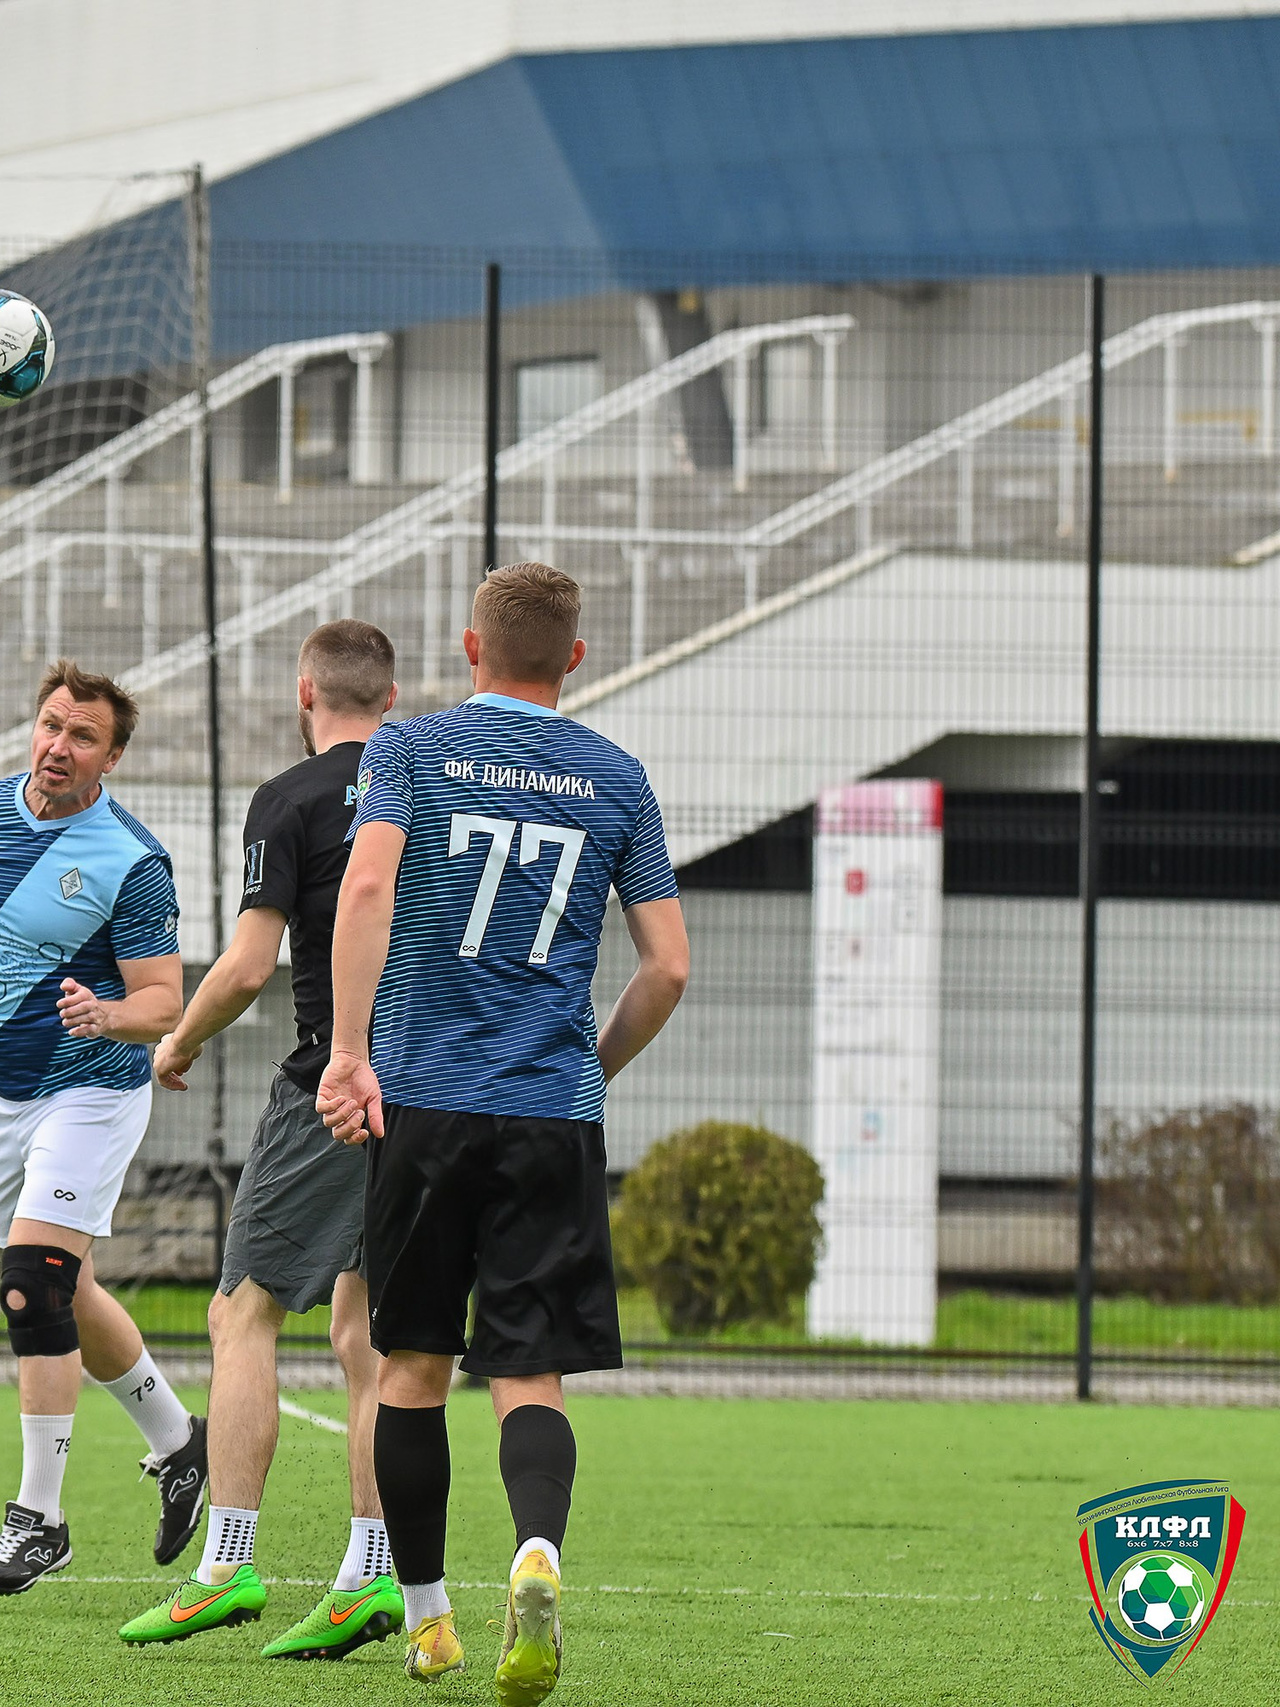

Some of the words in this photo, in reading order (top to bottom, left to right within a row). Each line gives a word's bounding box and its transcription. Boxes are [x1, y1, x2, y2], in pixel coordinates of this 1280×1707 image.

[444, 760, 476, 781] ФК
[481, 763, 596, 800] ДИНАМИКА
[448, 812, 588, 964] 77
[129, 1376, 156, 1402] 79
